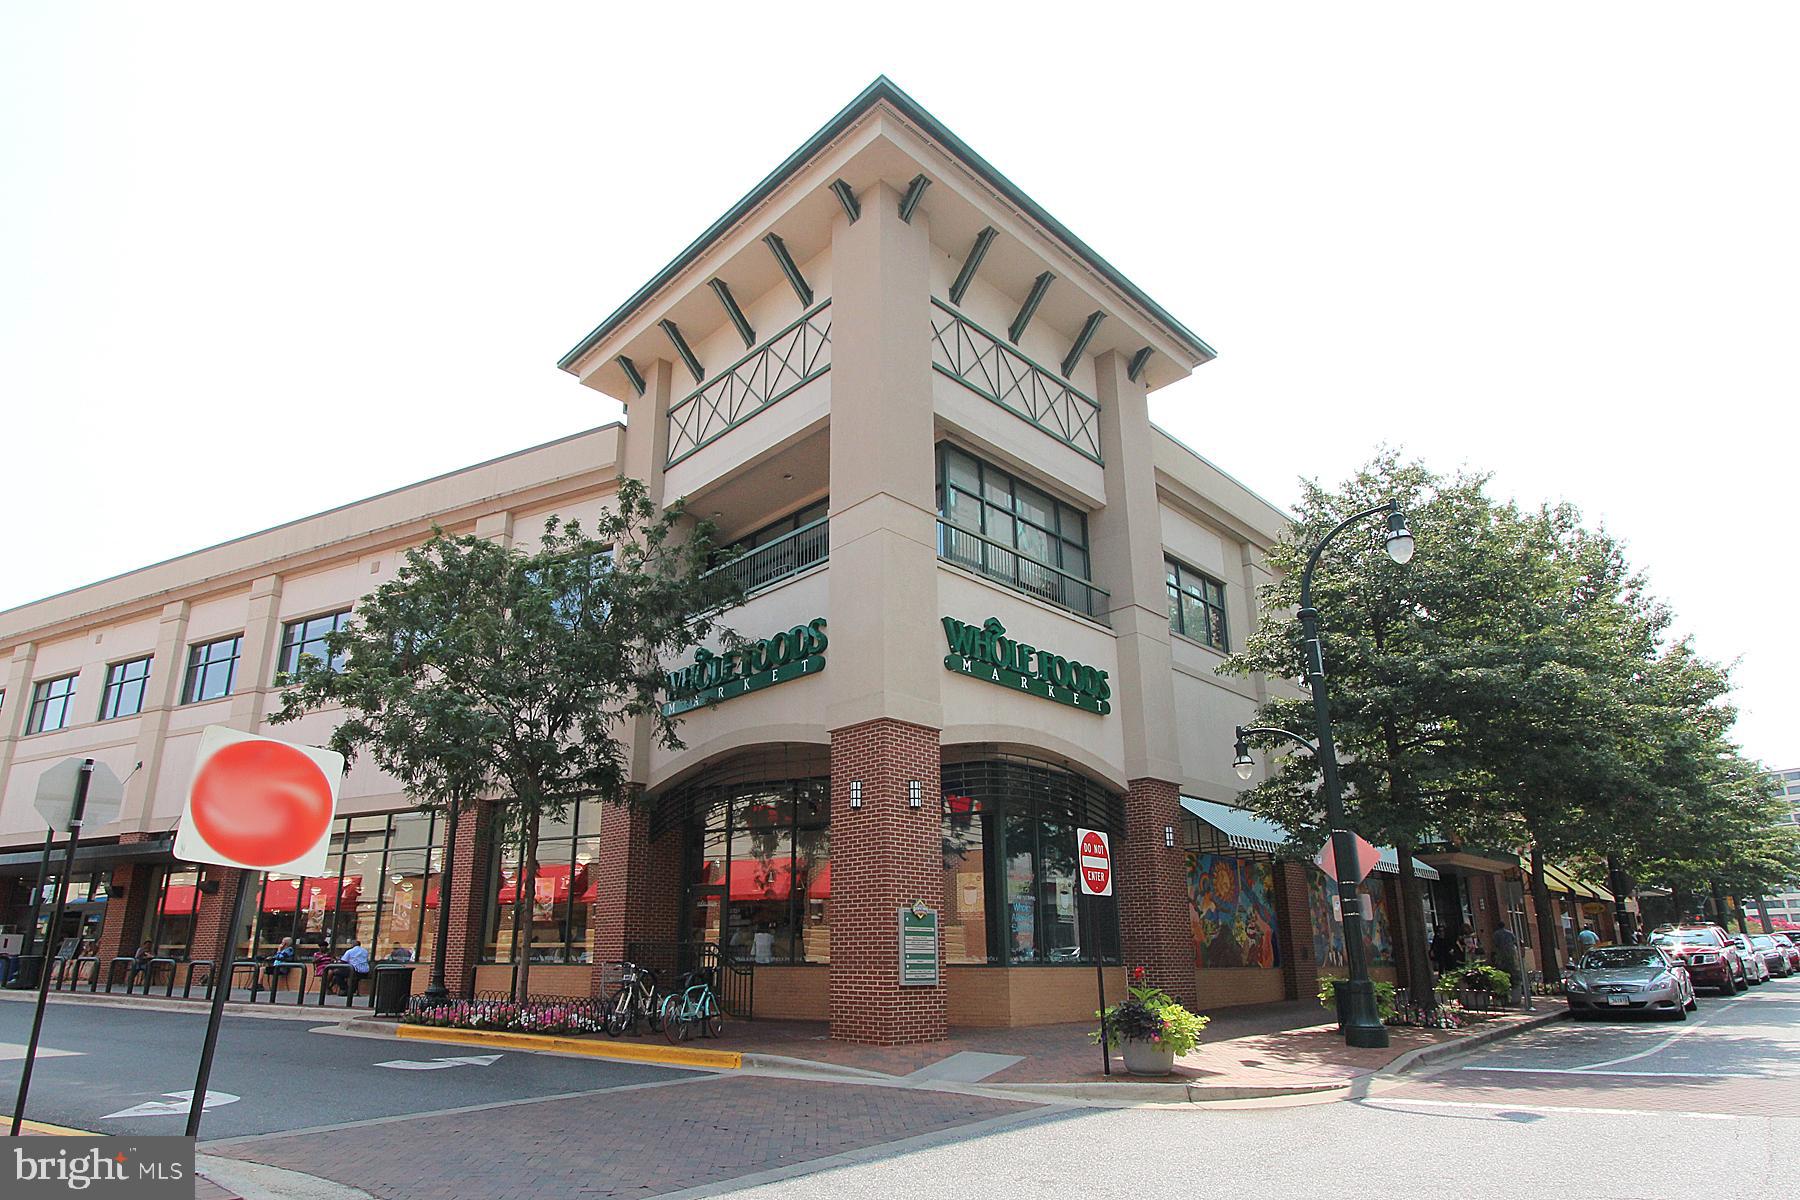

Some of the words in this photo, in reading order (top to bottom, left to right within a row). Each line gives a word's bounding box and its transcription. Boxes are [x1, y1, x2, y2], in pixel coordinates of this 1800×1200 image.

[941, 616, 1039, 678] WHOLE
[1037, 650, 1111, 700] FOODS
[962, 658, 1103, 712] MARKET
[668, 659, 809, 715] MARKET
[1083, 842, 1092, 853] DO
[1093, 844, 1104, 855] NOT
[1087, 870, 1105, 882] ENTER
